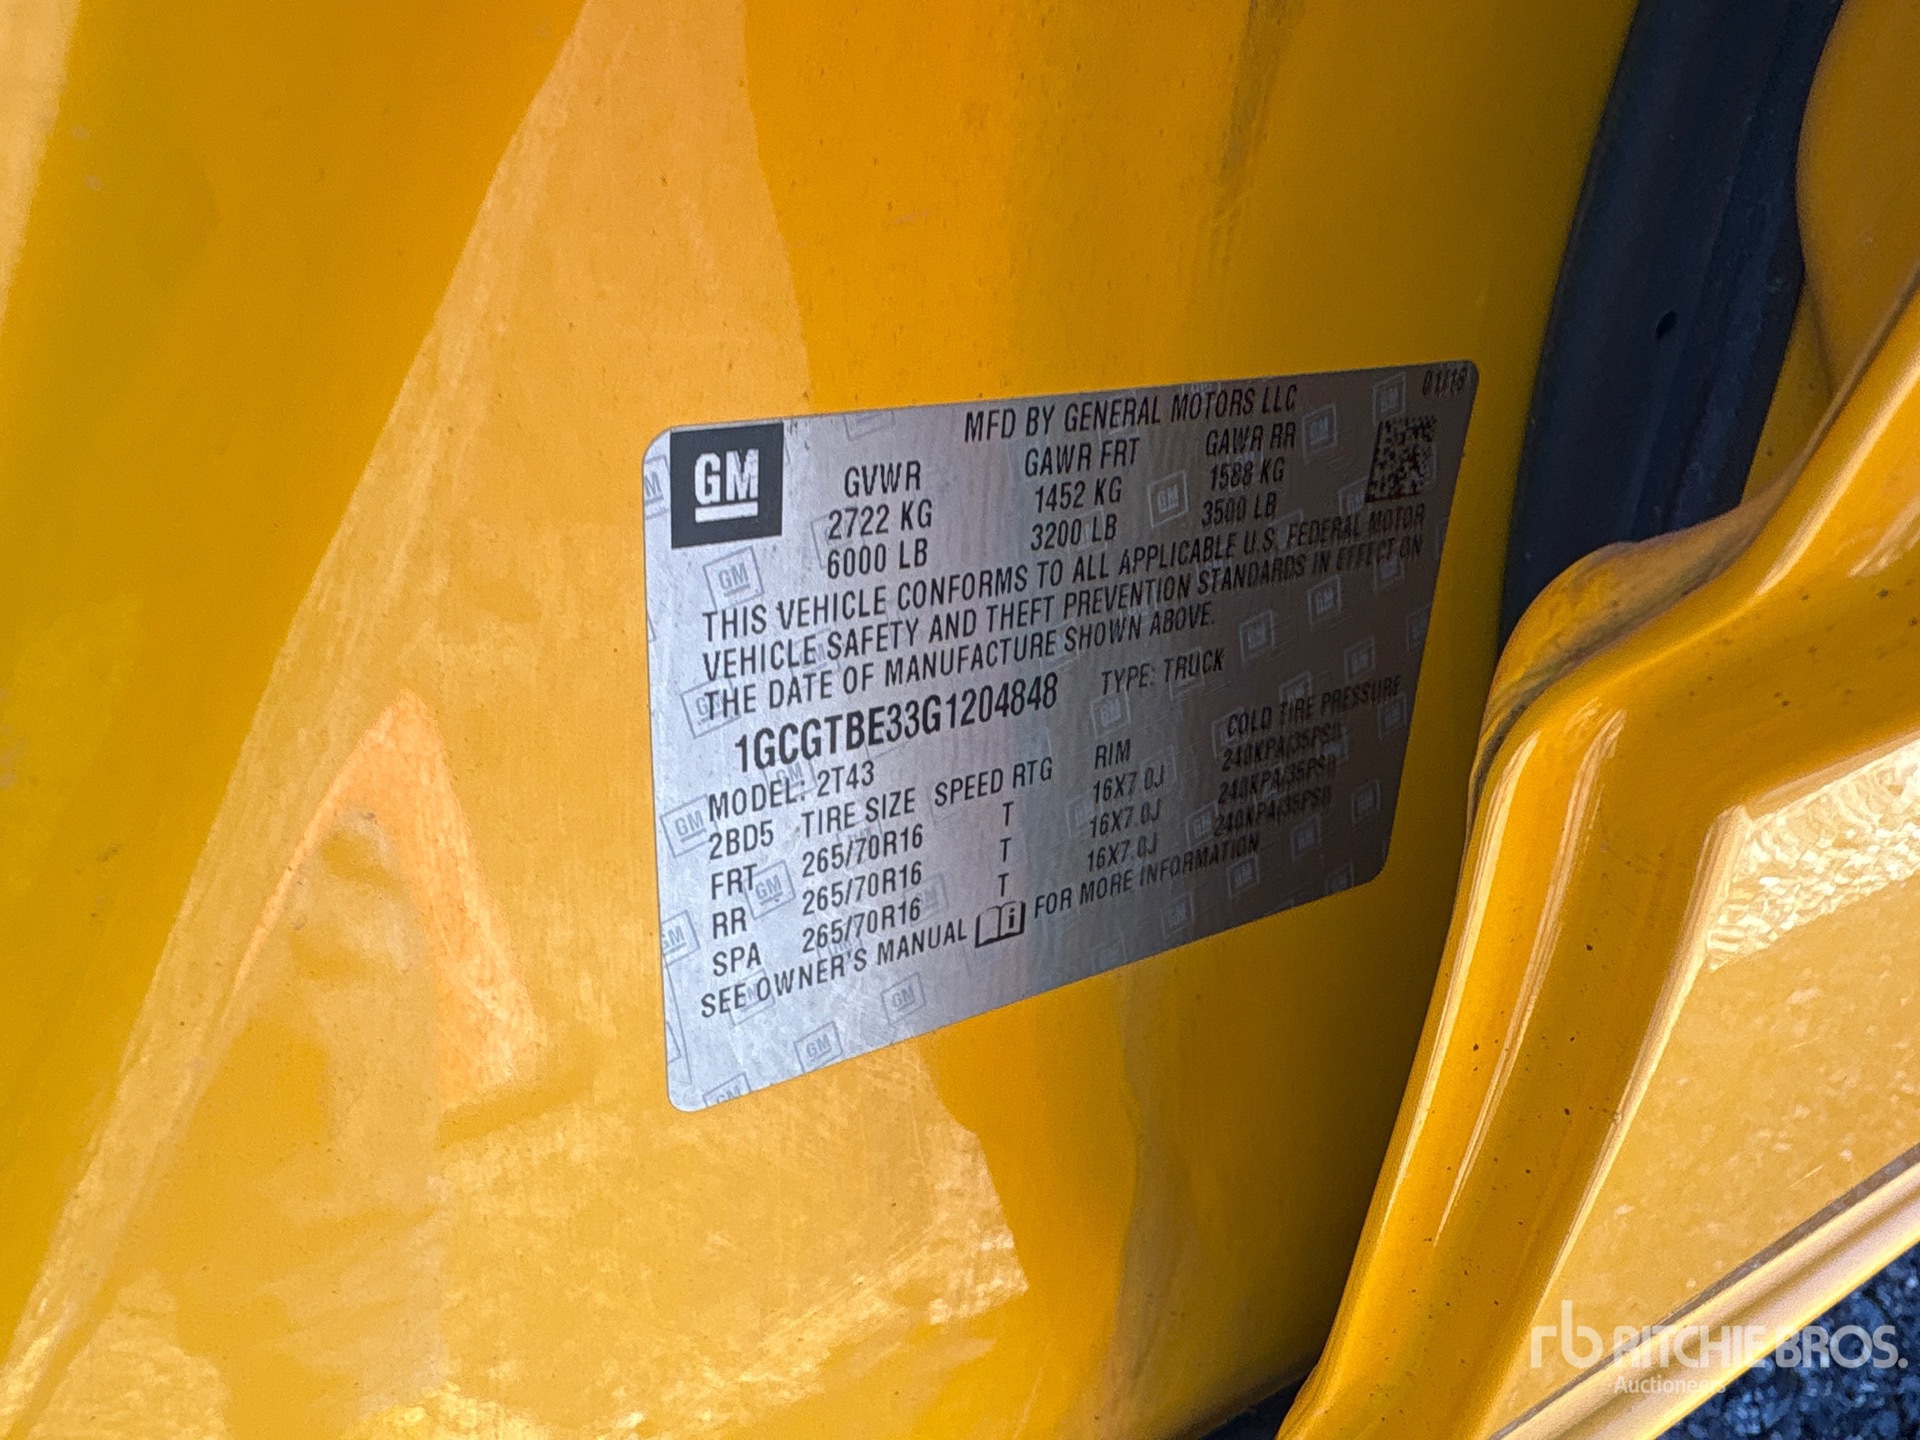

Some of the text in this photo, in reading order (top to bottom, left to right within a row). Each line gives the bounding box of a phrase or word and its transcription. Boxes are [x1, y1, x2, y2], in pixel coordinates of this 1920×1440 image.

[964, 383, 1298, 443] MFD BY GENERAL MOTORS LLC
[1024, 436, 1140, 477] GAWR FRT
[1205, 424, 1264, 457] GAWR
[1270, 421, 1296, 450] RR
[694, 449, 759, 505] GM
[844, 460, 921, 497] GVWR
[1211, 456, 1285, 491] 1588 KG
[1035, 477, 1122, 514] 1452 KG
[1202, 492, 1277, 527] 3500 LB
[827, 500, 932, 541] 2722 KG
[1030, 513, 1116, 551] 3200 LB
[702, 602, 767, 642] THIS
[776, 585, 886, 630] VEHICLE
[898, 567, 1028, 612] CONFORMS
[1037, 559, 1062, 587] TO
[1073, 551, 1110, 584] ALL
[1119, 531, 1237, 576] APPLICABLE
[1286, 513, 1359, 548] FEDERAL
[1369, 503, 1425, 534] MOTOR
[718, 560, 749, 592] GM
[827, 538, 928, 579] 6000 LB
[703, 533, 1424, 681] VEHICLE SAFETY AND THEFT PREVENTION STANDARDS IN EFFECT ON
[704, 688, 756, 720] THE
[769, 671, 832, 710] DATE
[843, 663, 874, 694] OF
[885, 629, 1056, 685] MANUFACTURE
[1064, 615, 1142, 651] SHOWN
[1102, 649, 1225, 696] TYPE: TRUCK
[734, 671, 1059, 773] 1GCGTBE33G1204848
[1227, 674, 1401, 738] COLD TIRE PRESSURE
[1094, 738, 1131, 770] RIM
[708, 760, 875, 822] MODEL: 2T43
[934, 757, 1053, 807] SPEED RTG
[674, 810, 704, 836] GM
[801, 787, 916, 839] TIRE SIZE
[1002, 801, 1015, 827] T
[708, 820, 774, 861] 2BD5
[802, 824, 924, 878] 265/70R16
[1000, 838, 1012, 862] T
[711, 864, 758, 901] FRT
[755, 874, 781, 900] GM
[802, 861, 922, 915] 265/70R16
[998, 874, 1010, 897] T
[1034, 887, 1072, 918] FOR
[1080, 869, 1133, 906] MORE
[1139, 835, 1260, 885] INFORMATION
[712, 907, 747, 940] RR
[802, 899, 921, 954] 265/70R16
[701, 922, 968, 1018] SEE OWNER'S MANUAL
[712, 942, 762, 977] SPA
[806, 1034, 830, 1058] GM
